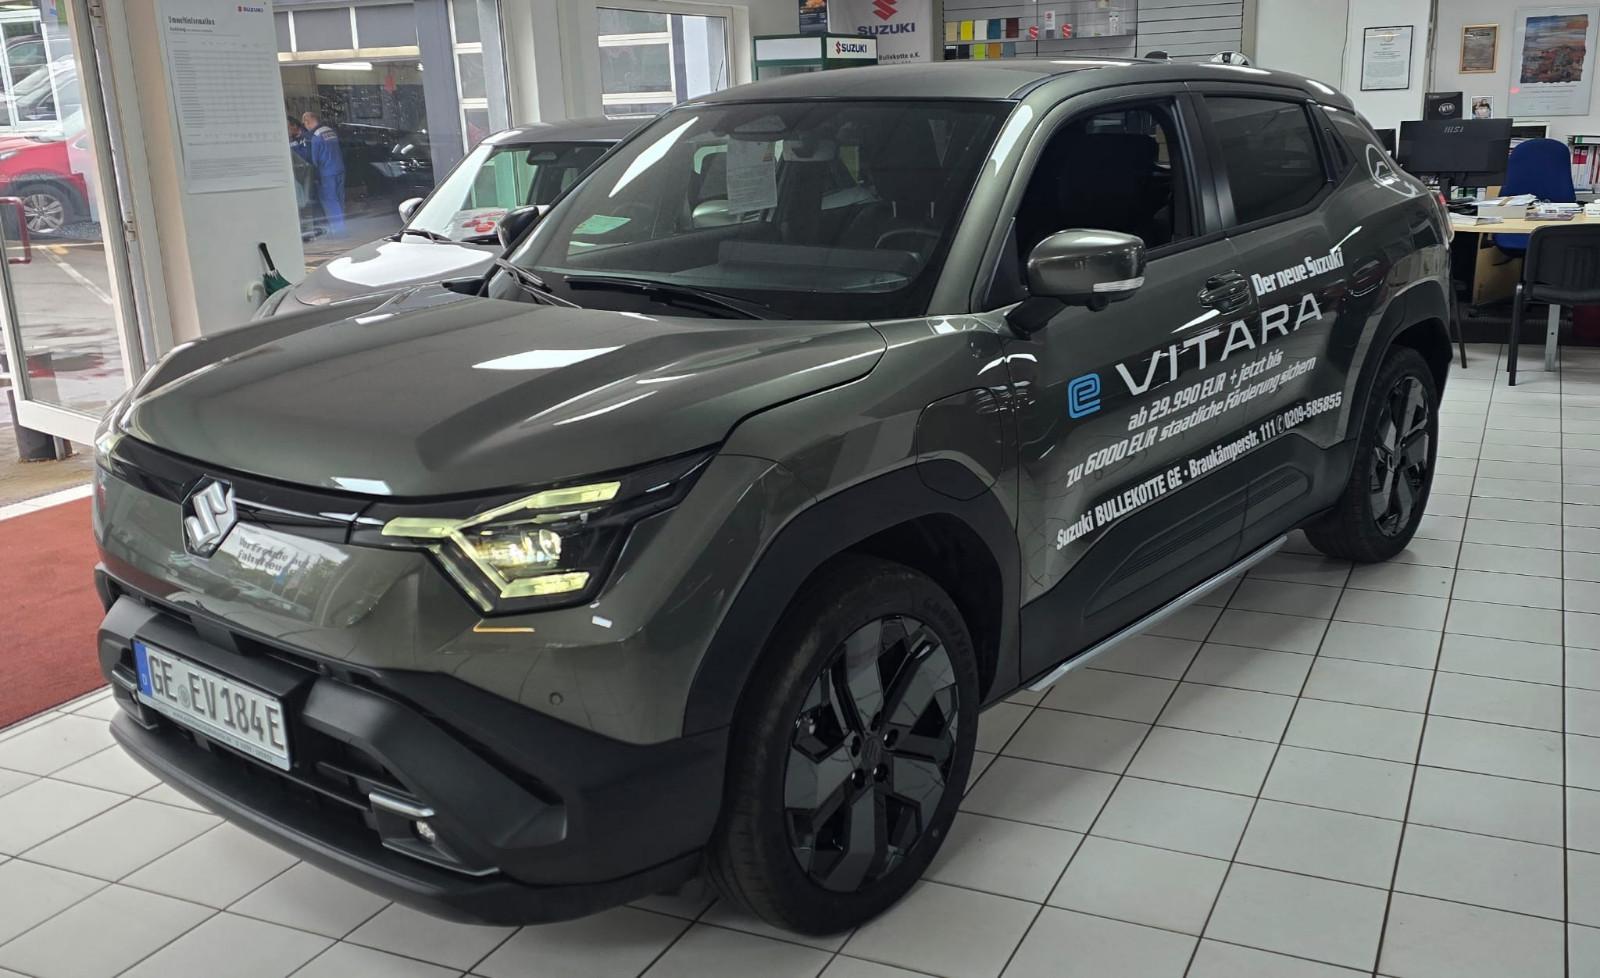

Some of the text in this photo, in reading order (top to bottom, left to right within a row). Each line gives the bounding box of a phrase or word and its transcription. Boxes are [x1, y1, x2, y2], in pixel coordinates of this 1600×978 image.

[841, 43, 867, 53] SUZUKI
[857, 22, 915, 36] SUZUKI
[1251, 246, 1344, 297] Der neue Suzuki
[1115, 293, 1322, 396] VITARA
[1066, 357, 1317, 488] zu 6000 EUR staatliche Förderung sichern
[1128, 406, 1147, 431] ab
[1148, 383, 1201, 423] 29.990
[1199, 372, 1227, 399] EUR
[1234, 356, 1267, 389] jetzt
[1265, 349, 1284, 370] bis
[1056, 510, 1094, 551] Suzuki
[1095, 474, 1167, 527] BULLEKOTTE
[1167, 466, 1183, 490] GE
[1188, 430, 1260, 479] Braukämperstr.
[1259, 420, 1276, 441] 111
[1284, 391, 1342, 429] 0209-585855
[149, 655, 177, 702] GE
